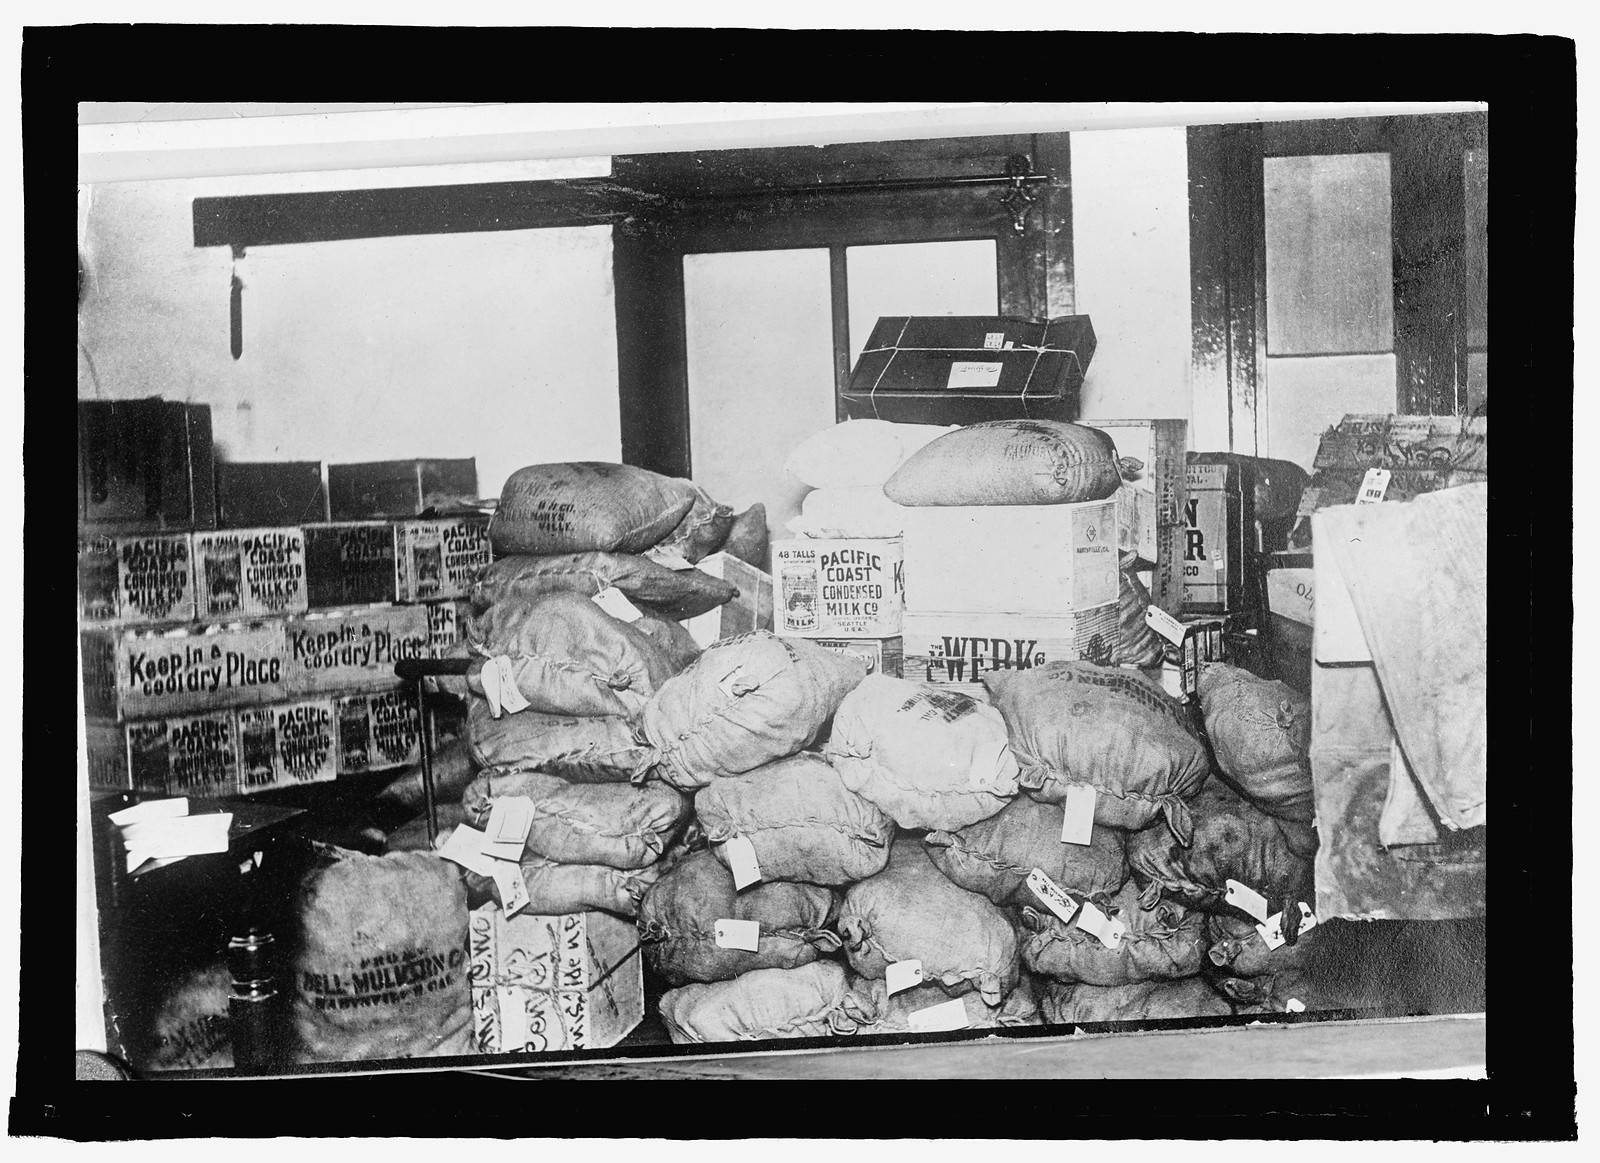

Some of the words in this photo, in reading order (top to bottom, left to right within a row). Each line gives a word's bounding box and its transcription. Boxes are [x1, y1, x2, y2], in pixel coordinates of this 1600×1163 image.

[443, 523, 488, 543] PACIFIC
[123, 540, 186, 563] PACIFIC
[243, 533, 300, 556] PACIFIC
[448, 538, 480, 553] COAST
[779, 551, 790, 559] 48
[792, 550, 816, 559] TALLS
[129, 556, 175, 573] COAST
[250, 548, 291, 565] COAST
[820, 549, 881, 572] PACIFIC
[247, 564, 301, 582] CONDENSED
[826, 567, 872, 582] COAST
[251, 582, 282, 599] MILK
[822, 584, 882, 600] CONDENSED
[826, 602, 860, 616] MILK
[787, 617, 815, 627] MILK
[291, 629, 338, 661] Keep
[304, 649, 339, 670] cool
[342, 643, 372, 668] dry
[375, 629, 422, 663] Place
[129, 652, 182, 687] Keep
[185, 645, 202, 670] In
[941, 636, 1038, 682] WERK
[143, 672, 183, 697] cool
[187, 666, 221, 693] dry
[226, 651, 280, 688] Place
[279, 706, 329, 731] PACIFIC
[173, 720, 229, 748] PACIFIC
[284, 720, 321, 740] COAST
[280, 734, 330, 757] CONDENSED
[284, 753, 313, 774] MILK
